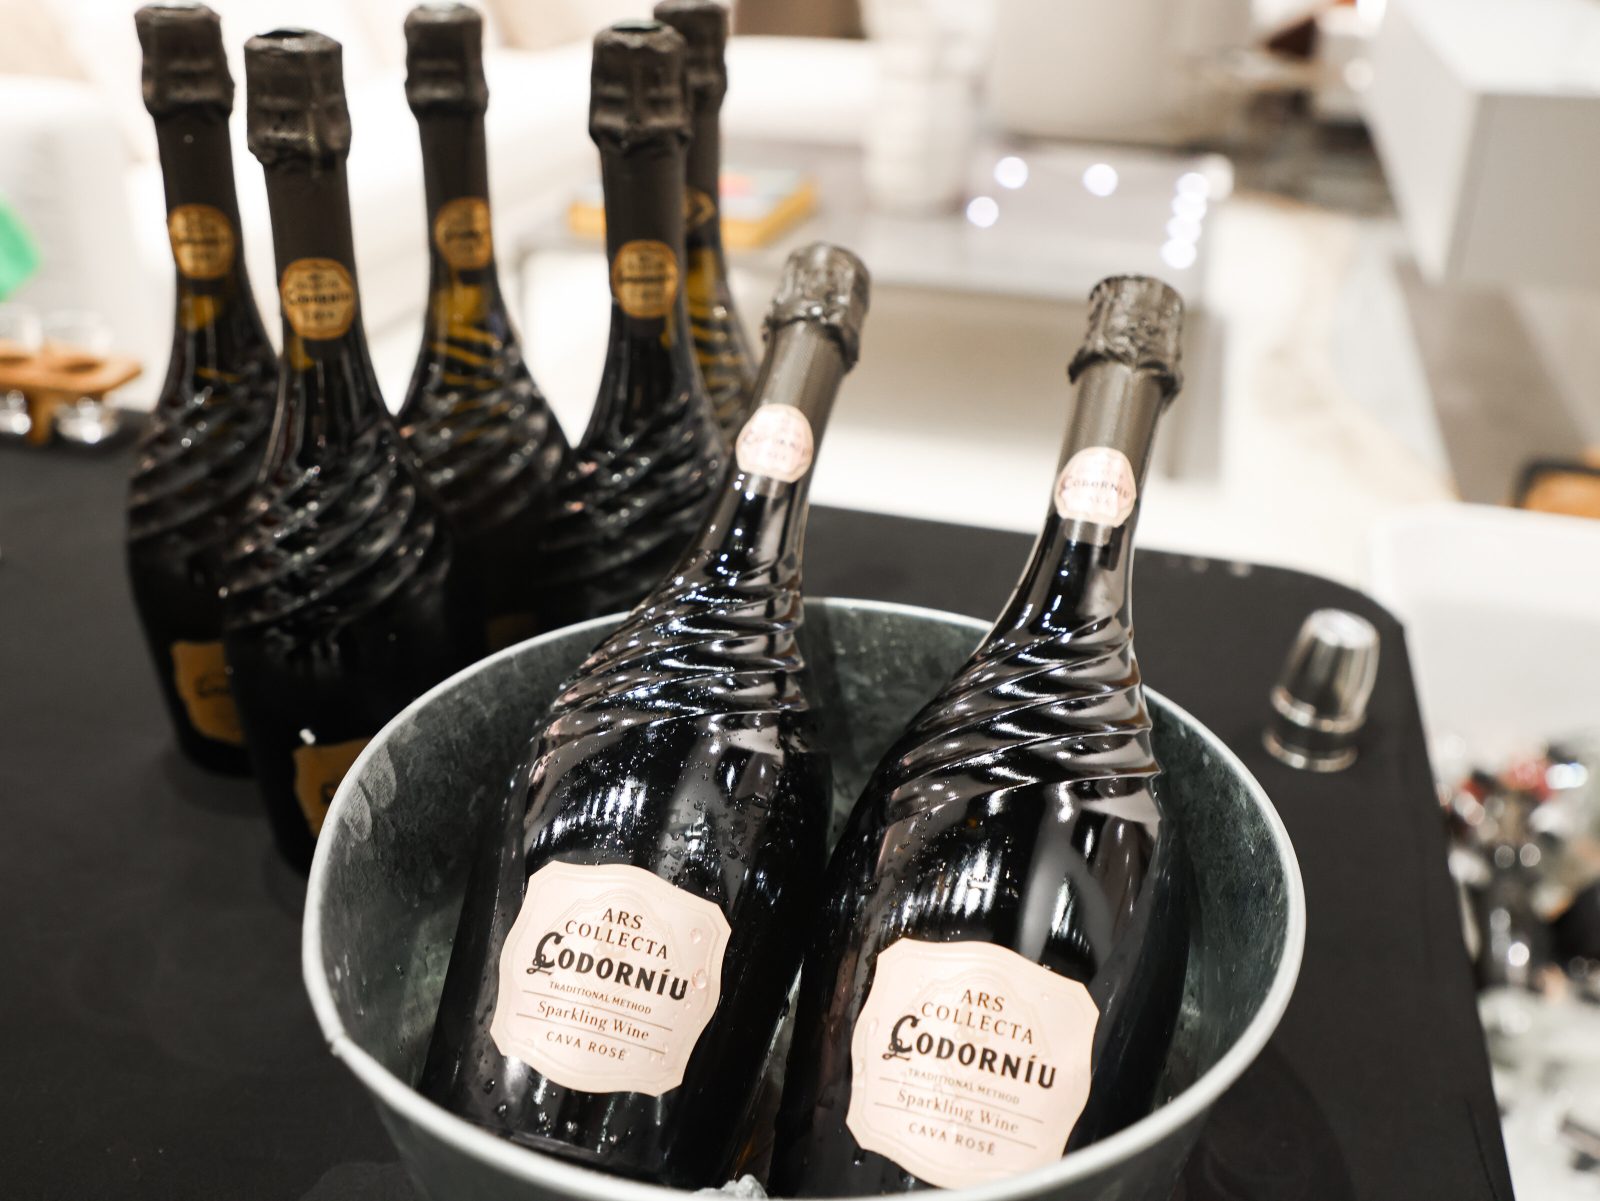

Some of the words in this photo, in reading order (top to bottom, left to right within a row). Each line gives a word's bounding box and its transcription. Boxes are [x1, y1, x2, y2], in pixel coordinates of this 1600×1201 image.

[602, 908, 643, 930] ARS
[565, 920, 668, 960] COLLECTA
[526, 932, 689, 1001] CODORNÍU
[549, 981, 609, 1003] TRADITIONAL
[612, 998, 652, 1015] METHOD
[961, 989, 1005, 1012] ARS
[537, 1001, 608, 1031] Sparkling
[613, 1019, 650, 1041] Wine
[921, 1002, 1033, 1044] COLLECTA
[546, 1031, 581, 1048] CAVA
[588, 1041, 626, 1061] ROSÉ
[882, 1015, 1056, 1089] CODORNÍU
[908, 1068, 974, 1092] TRADITIONAL
[977, 1085, 1020, 1105] METHOD
[897, 1089, 974, 1122] Sparkling
[979, 1110, 1019, 1133] Wine
[908, 1122, 947, 1141] CAVA
